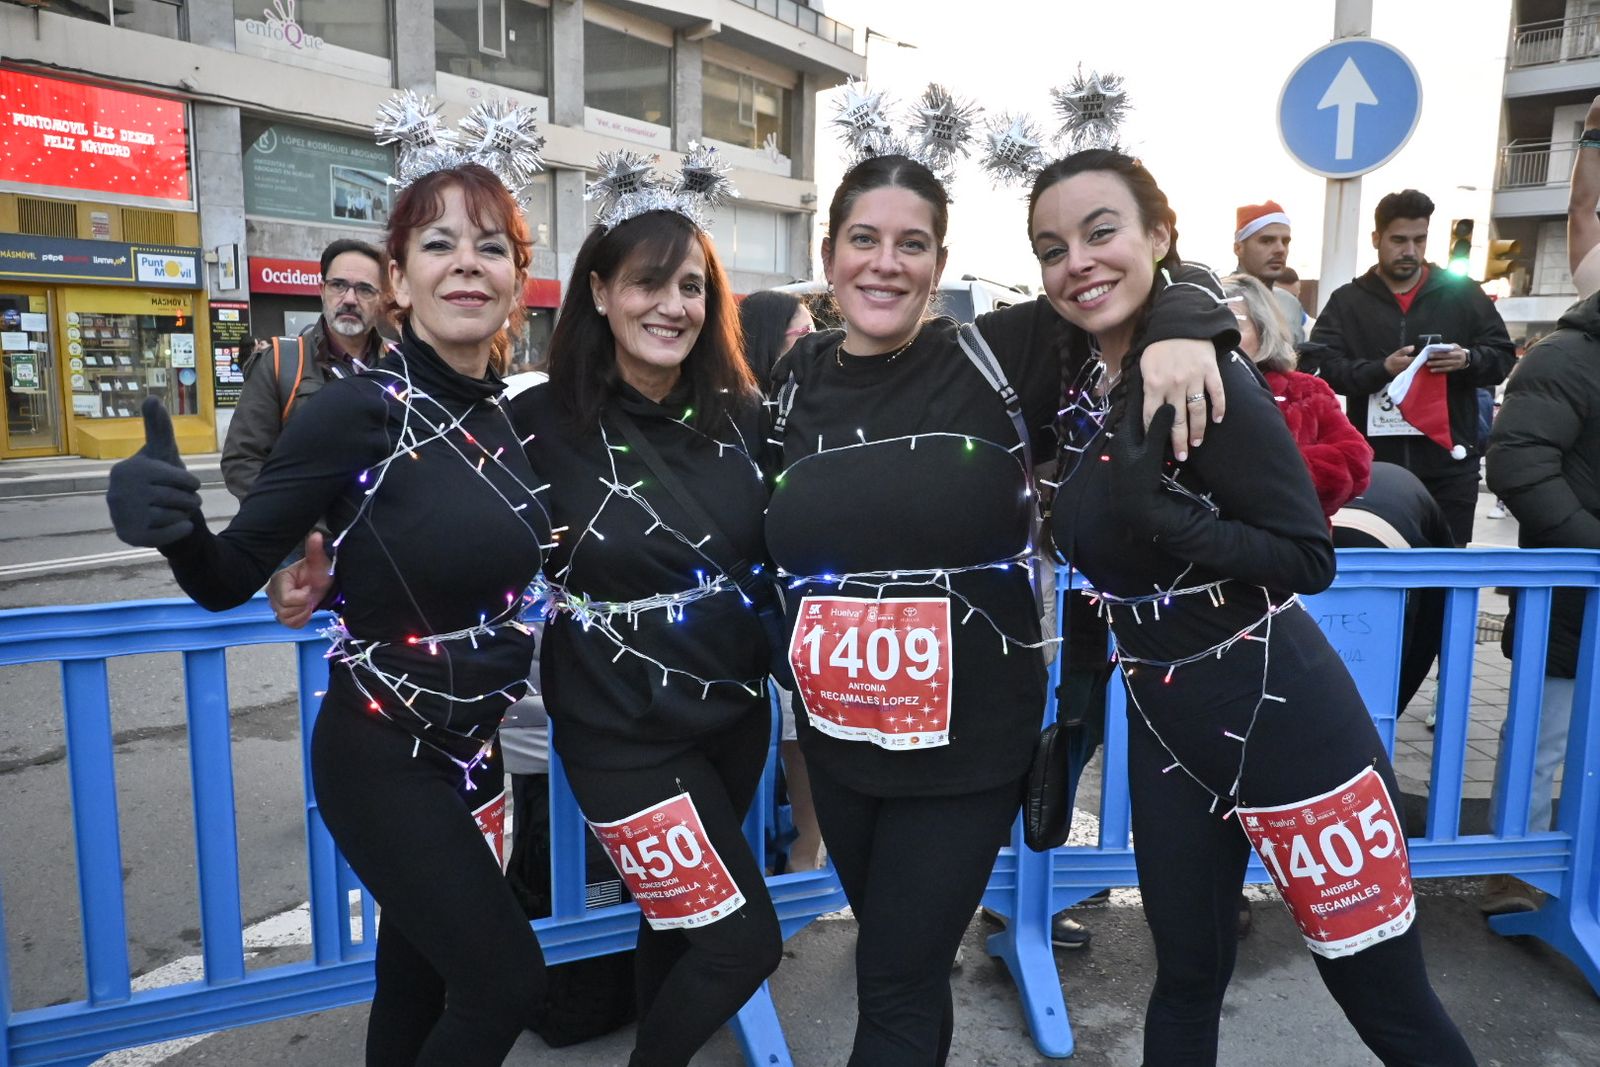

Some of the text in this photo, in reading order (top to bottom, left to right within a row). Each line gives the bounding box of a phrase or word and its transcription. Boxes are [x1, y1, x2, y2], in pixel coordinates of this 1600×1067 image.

[245, 20, 323, 49] enfoQue
[1079, 94, 1106, 103] HAPPY
[846, 102, 870, 119] HAPPY
[1083, 103, 1103, 111] NEW
[854, 111, 870, 124] NEW
[933, 113, 958, 125] HAPPY
[1082, 111, 1105, 120] YEAR
[407, 120, 430, 134] HAPPY
[494, 123, 519, 140] HAPPY
[857, 119, 876, 131] YEAR
[934, 122, 953, 131] NEW
[93, 125, 115, 140] LES
[414, 129, 430, 142] NEW
[494, 132, 513, 145] NEW
[932, 131, 952, 140] YEAR
[43, 134, 130, 158] FELIZ NAVIDAD
[281, 134, 305, 148] LÓPEZ
[307, 139, 349, 155] RODRÍGUEZ
[416, 136, 436, 149] YEAR
[491, 138, 512, 153] YEAR
[994, 133, 1012, 160] HAPPY
[1004, 141, 1017, 160] NEW
[612, 172, 637, 183] HAPPY
[618, 180, 635, 189] NEW
[618, 187, 638, 197] YEAR
[261, 268, 323, 285] Occident
[830, 608, 860, 619] Huelva
[802, 625, 940, 681] 1409
[848, 682, 887, 693] ANTONIA
[821, 690, 919, 706] RECAMALES LOPEZ
[1267, 817, 1297, 828] Huelva
[1259, 799, 1397, 888] 1405
[664, 881, 702, 898] BONILLA
[1319, 879, 1361, 898] ANDREA
[1310, 884, 1381, 914] RECAMALES
